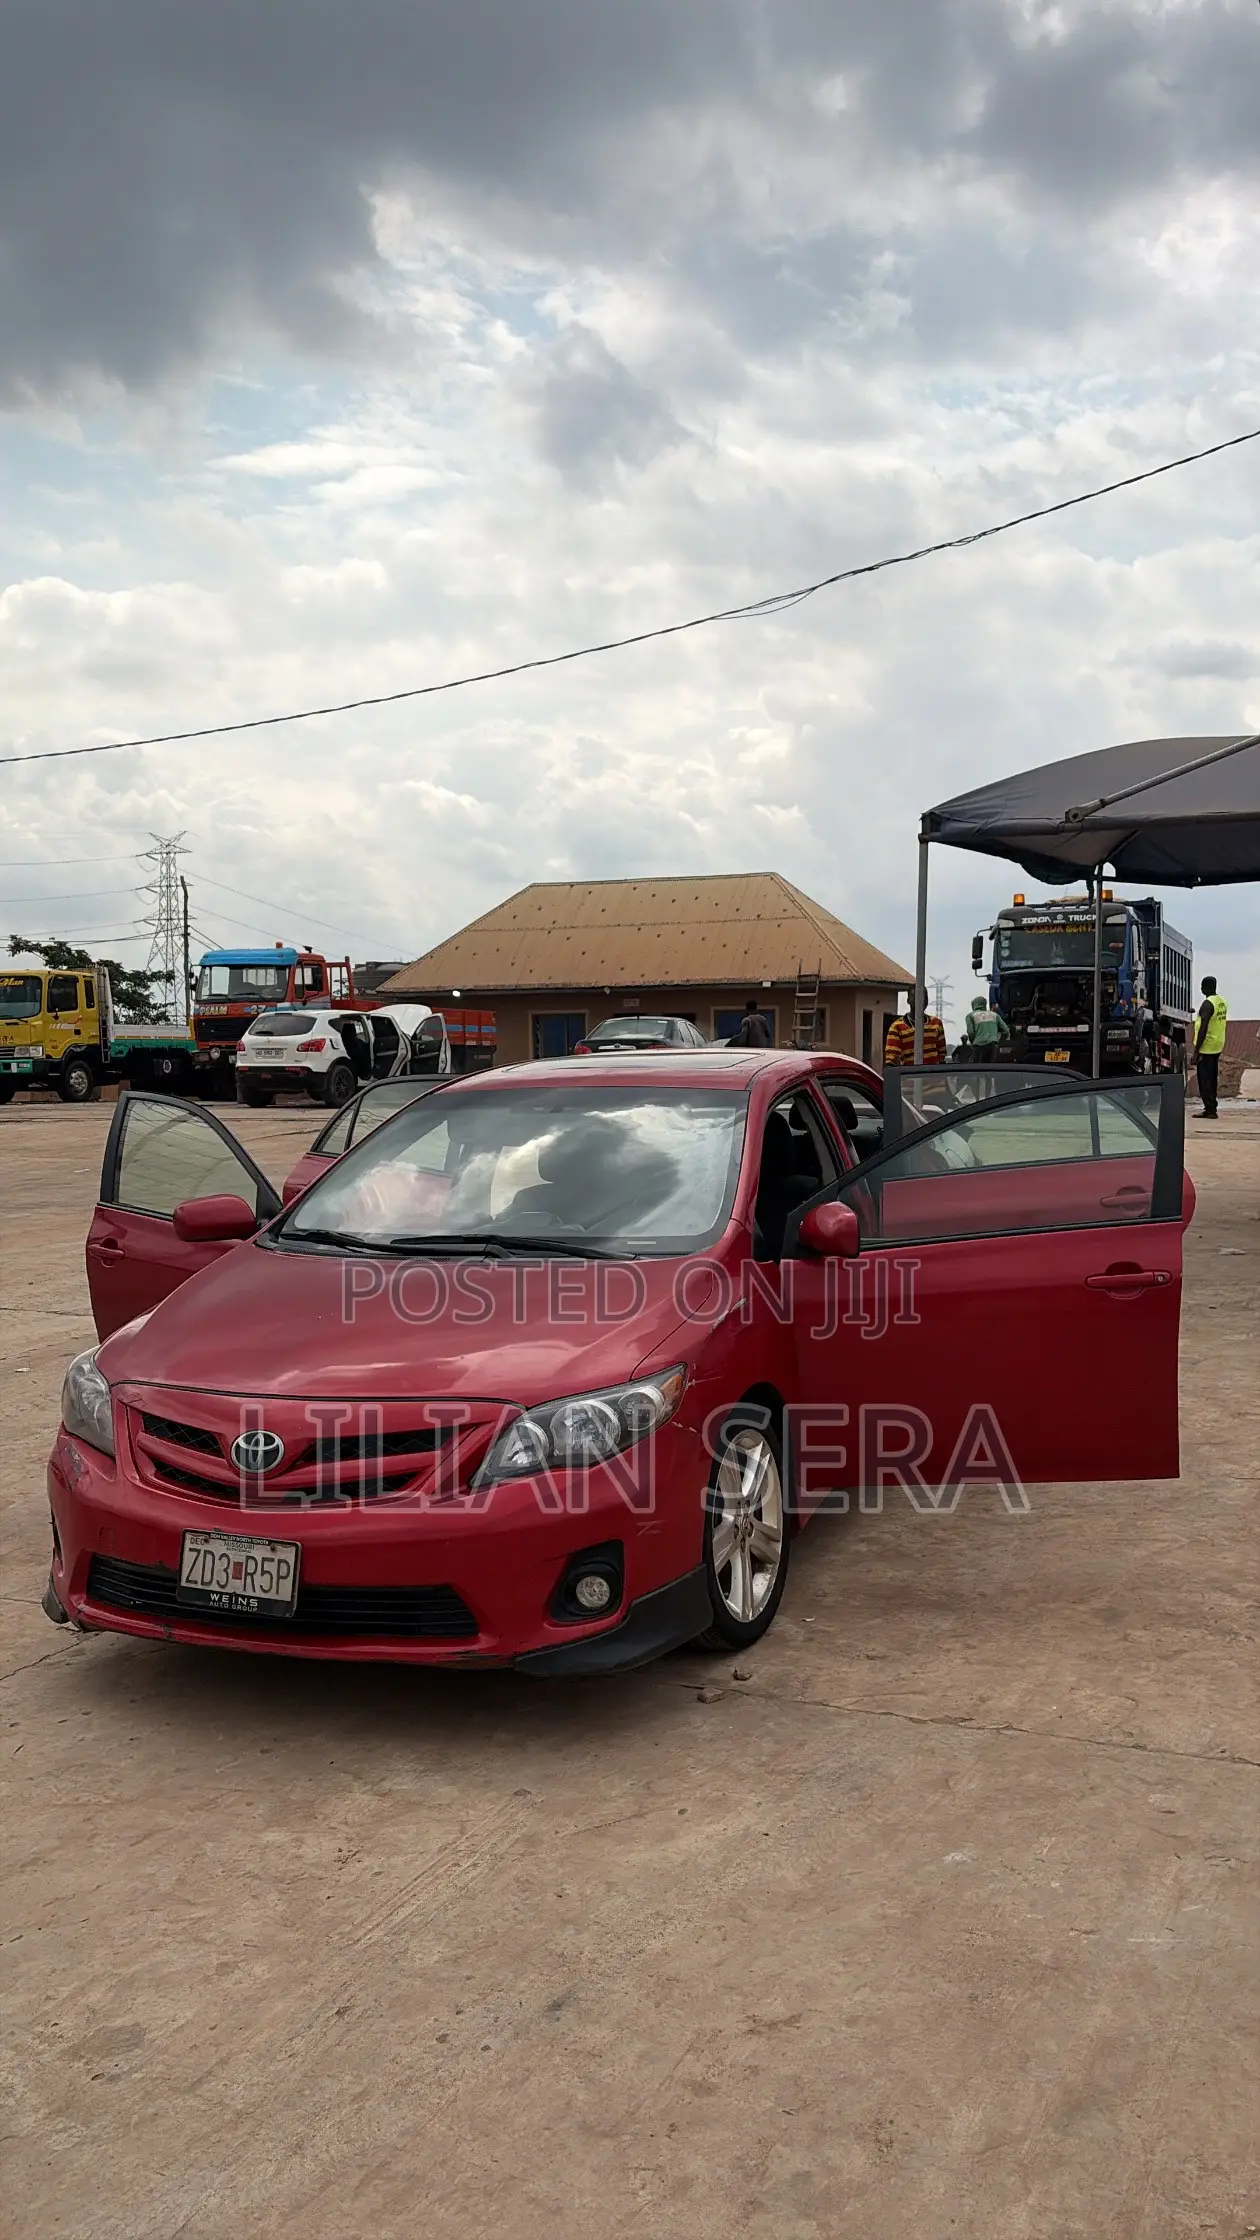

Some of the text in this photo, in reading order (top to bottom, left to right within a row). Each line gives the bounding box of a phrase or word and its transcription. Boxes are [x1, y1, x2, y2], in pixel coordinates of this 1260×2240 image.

[199, 1005, 228, 1016] PSALM
[250, 1004, 267, 1015] 27
[223, 1540, 255, 1551] MISSOURI
[185, 1547, 291, 1595] ZD3 R5P
[210, 1592, 259, 1607] WEINS
[208, 1601, 258, 1612] AUTO GROUP
